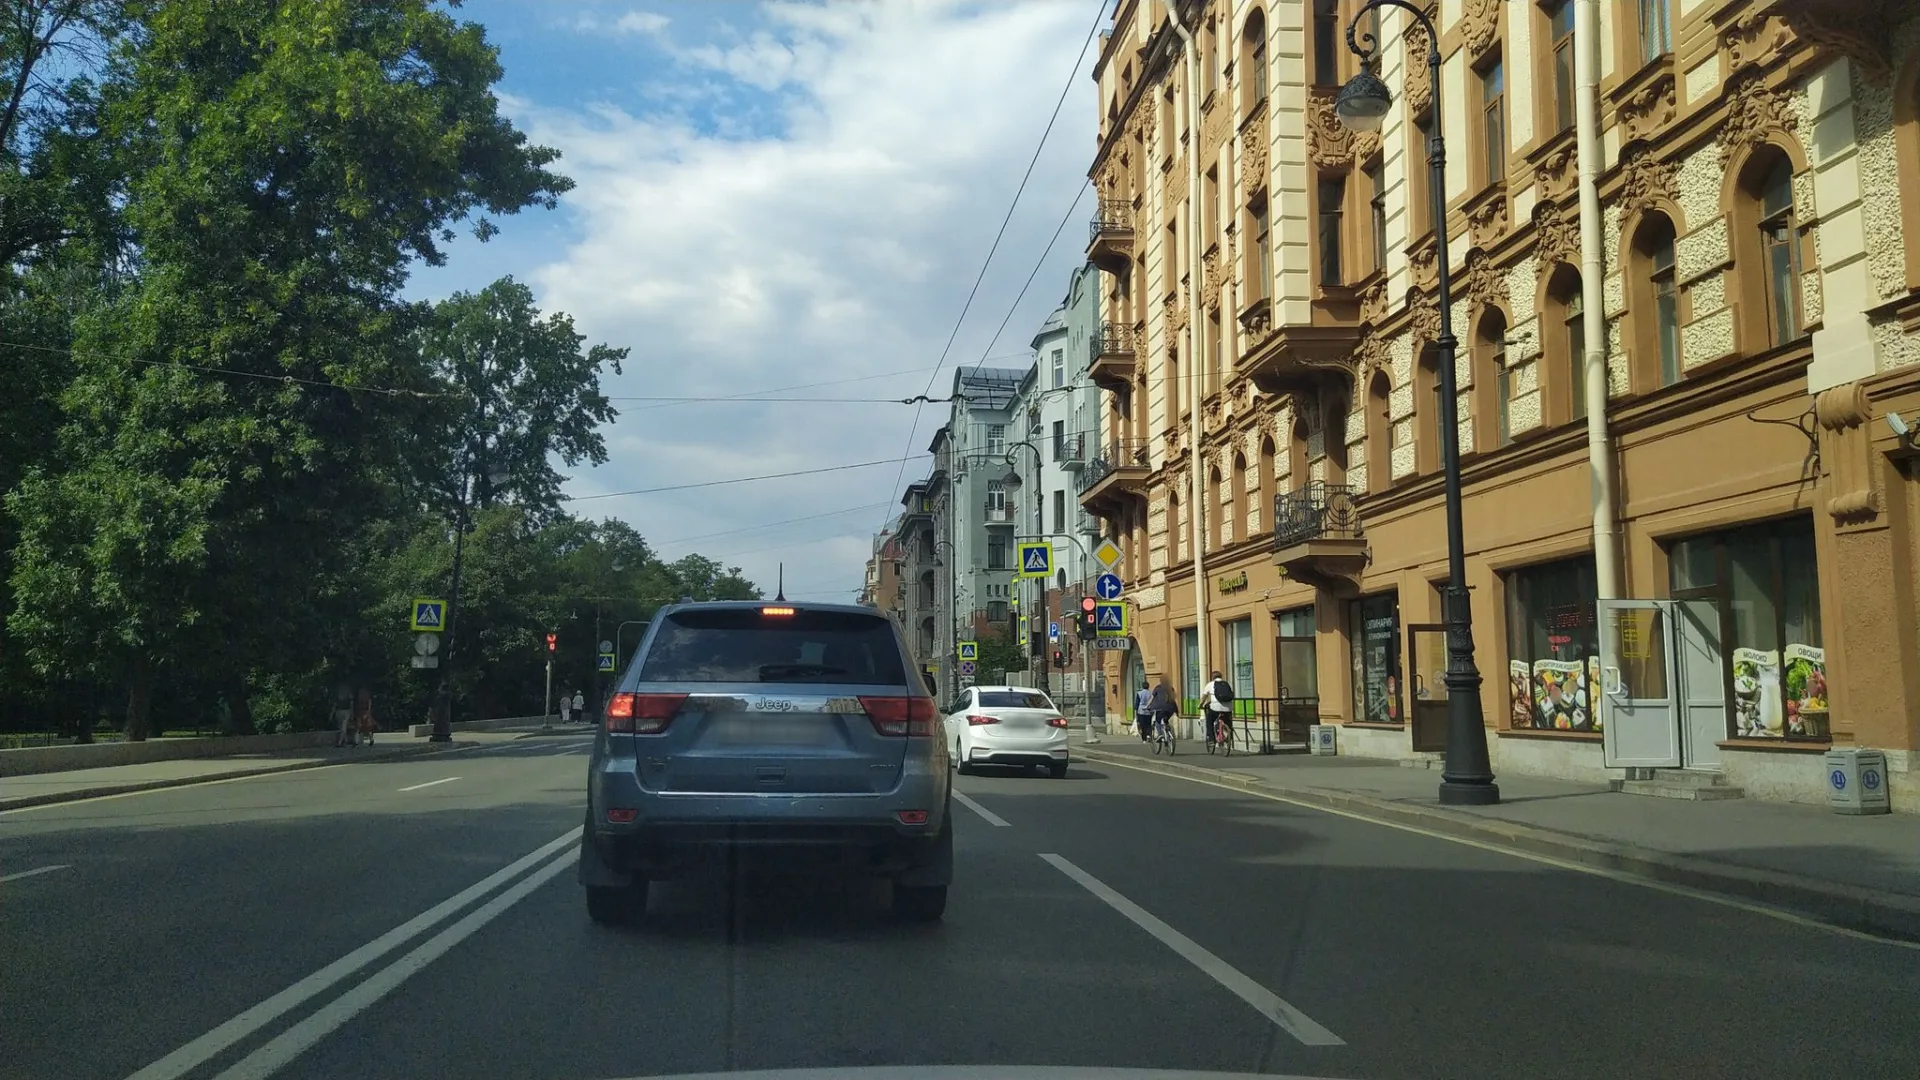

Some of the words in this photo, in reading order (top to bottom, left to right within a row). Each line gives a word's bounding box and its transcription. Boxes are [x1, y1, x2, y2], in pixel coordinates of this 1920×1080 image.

[1097, 639, 1126, 648] СТОП
[1743, 651, 1768, 663] МОЛОКО
[1797, 647, 1822, 660] ОВОЩИ
[755, 696, 792, 711] Jeep
